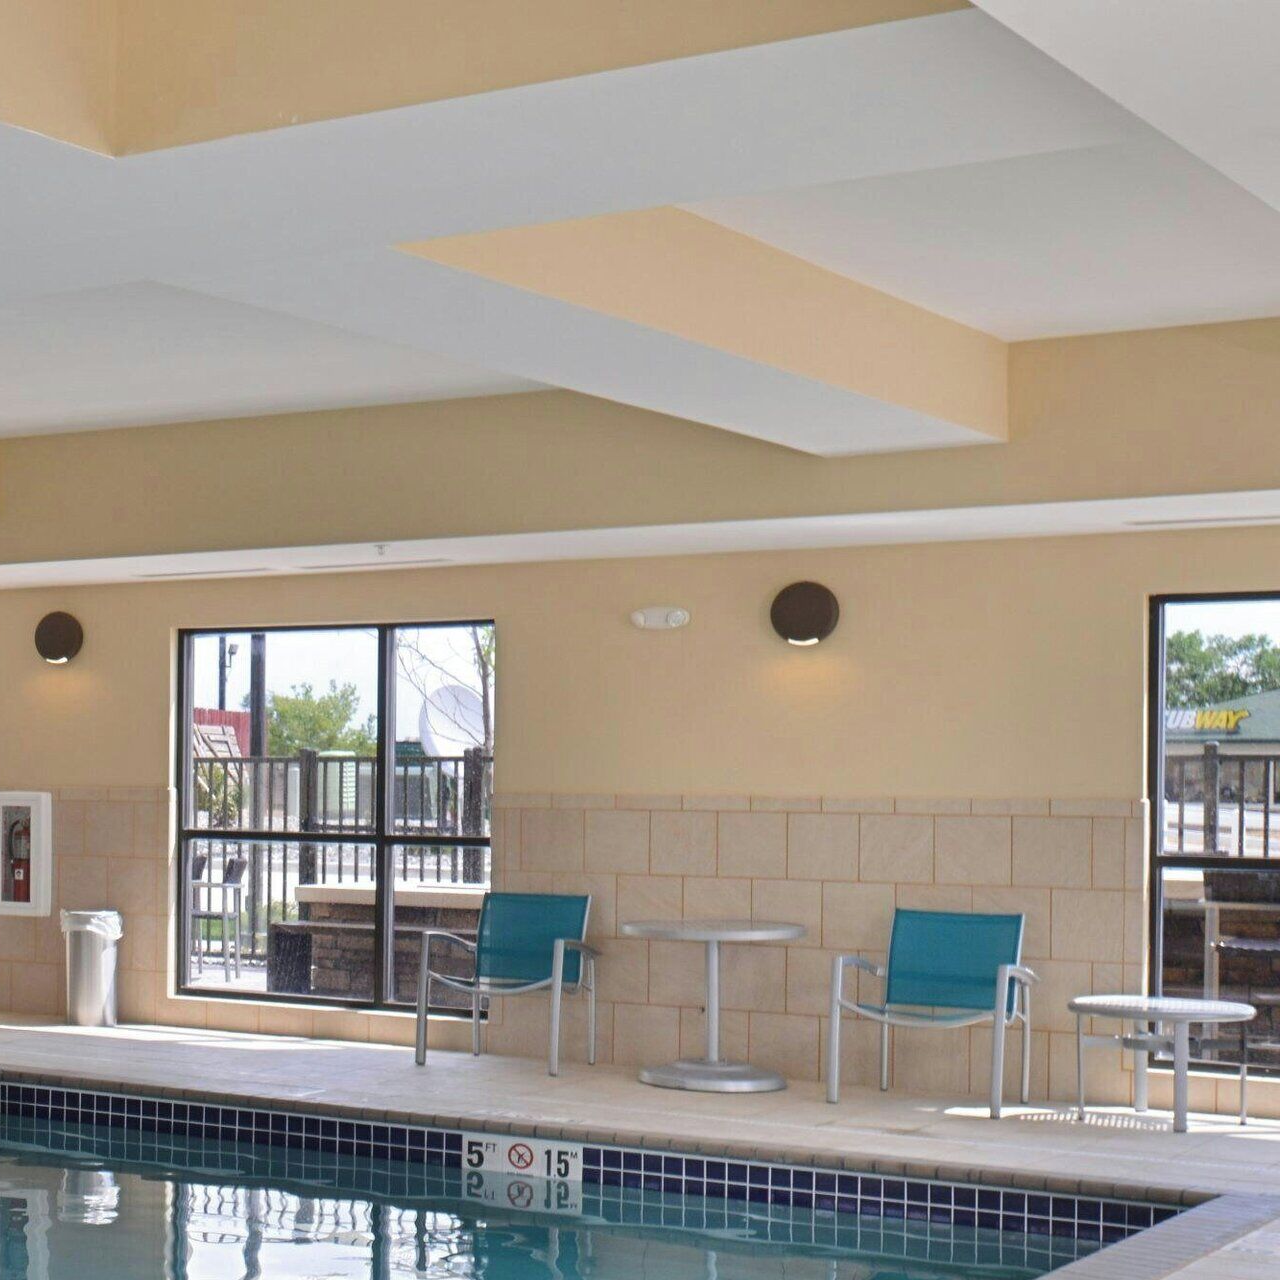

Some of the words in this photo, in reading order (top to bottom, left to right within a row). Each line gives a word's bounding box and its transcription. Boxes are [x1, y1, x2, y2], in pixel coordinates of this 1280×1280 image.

[1165, 709, 1249, 730] UBWAY
[467, 1141, 484, 1168] 5
[485, 1143, 497, 1153] FT
